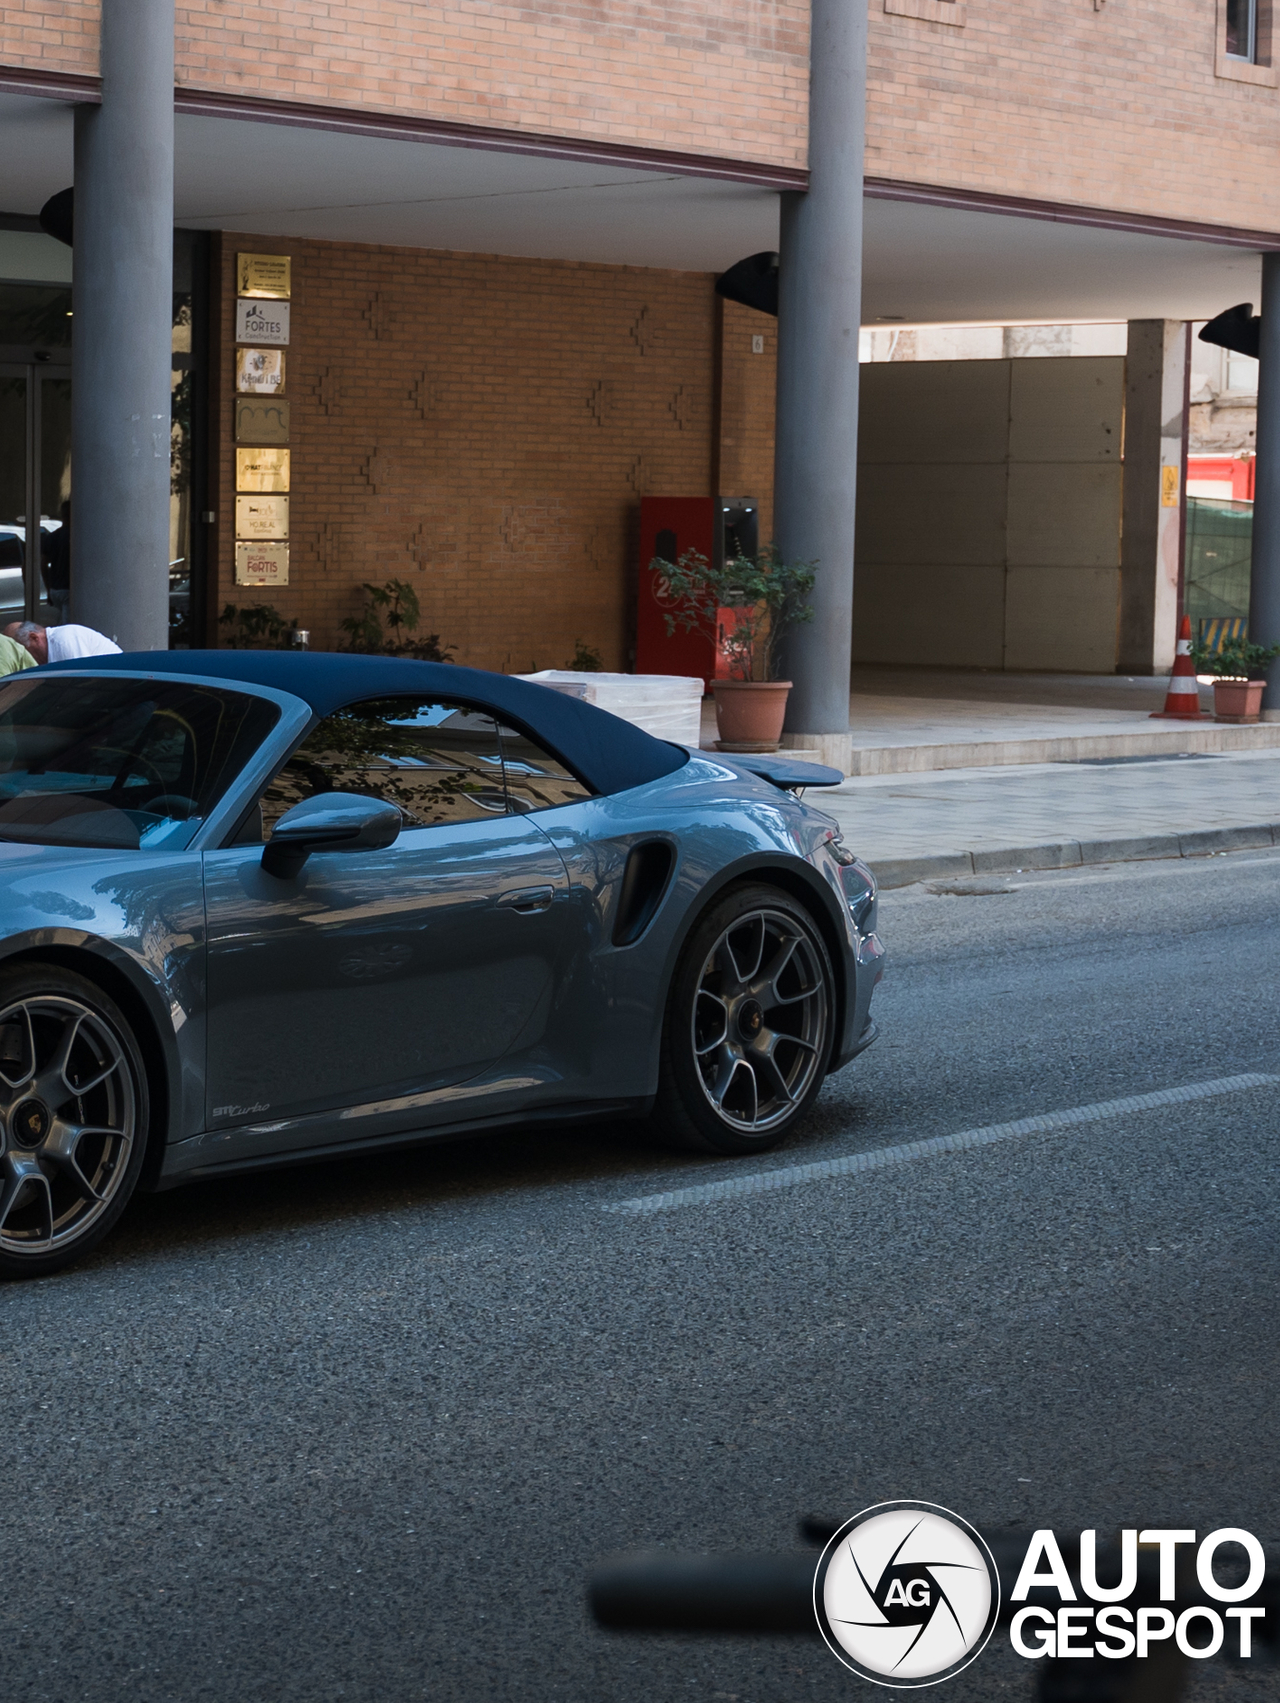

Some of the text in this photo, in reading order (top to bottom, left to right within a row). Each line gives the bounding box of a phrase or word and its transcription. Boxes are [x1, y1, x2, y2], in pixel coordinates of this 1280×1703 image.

[245, 321, 281, 333] FORTES
[755, 338, 761, 350] 6
[247, 561, 278, 573] FORTIS
